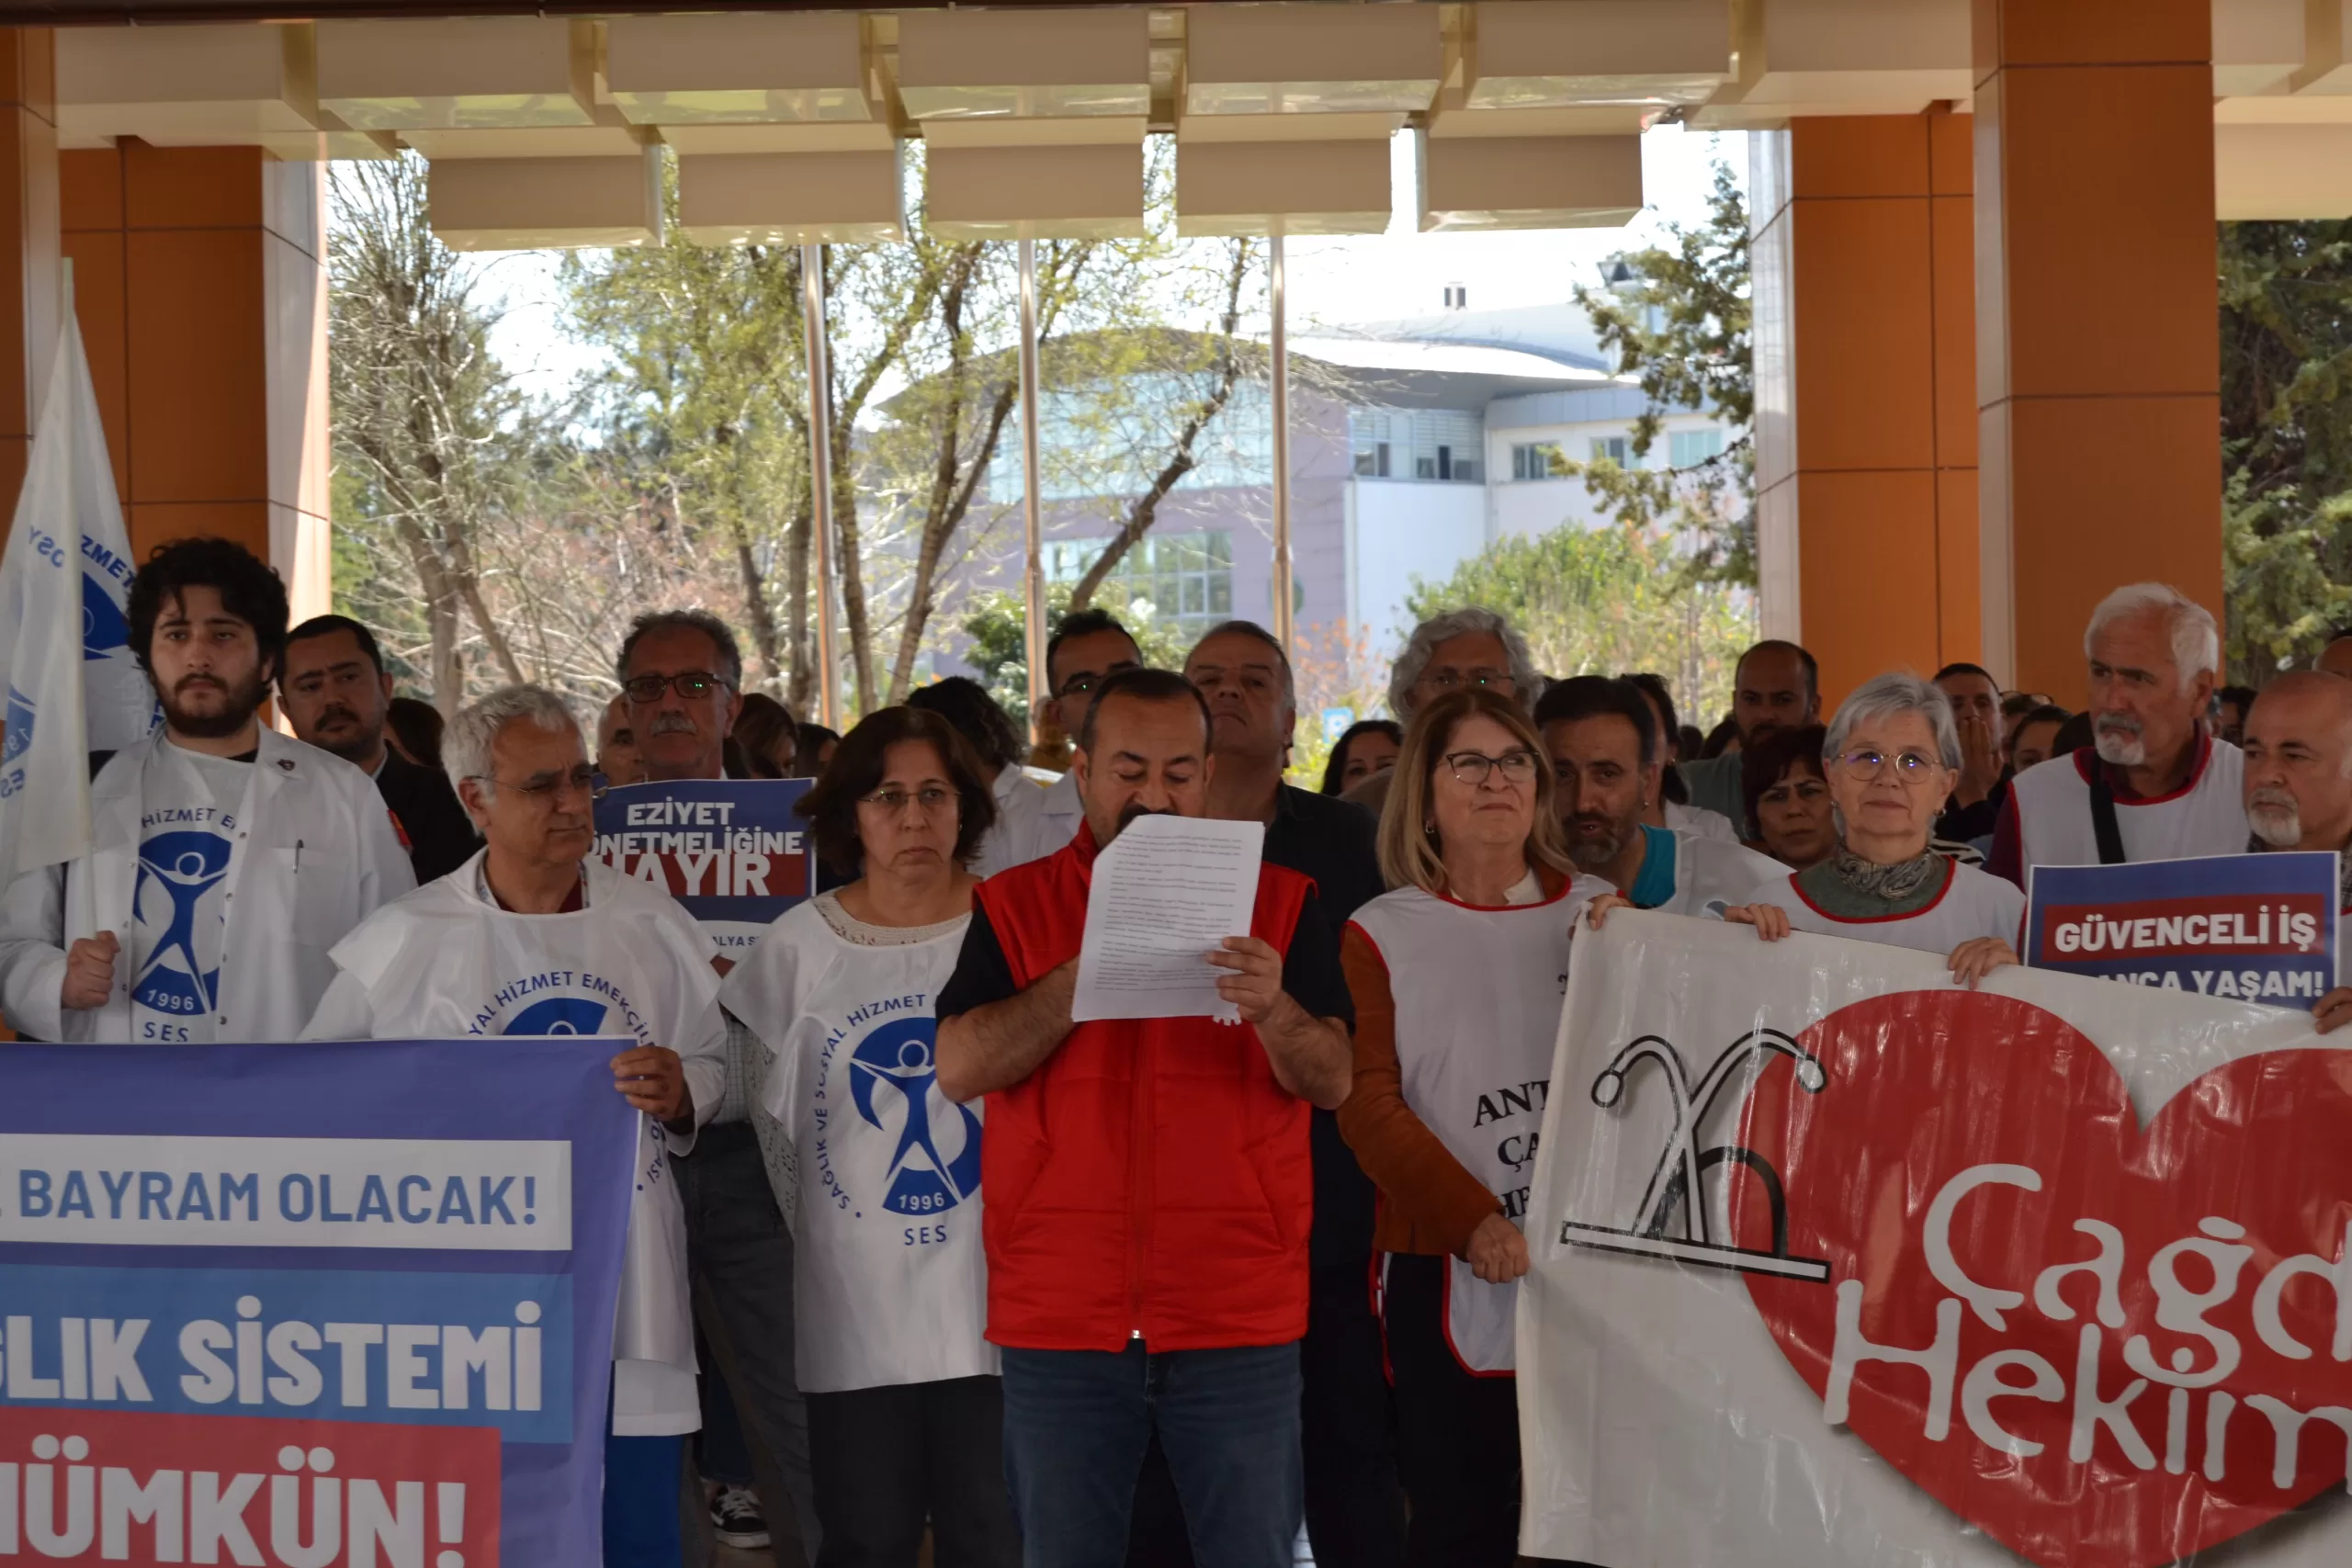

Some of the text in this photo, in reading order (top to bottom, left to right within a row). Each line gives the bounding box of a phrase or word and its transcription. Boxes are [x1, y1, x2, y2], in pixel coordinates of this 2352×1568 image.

[627, 795, 735, 826] EZİYET
[2055, 904, 2317, 953] GÜVENCELİ İŞ
[147, 988, 194, 1010] 1996
[494, 971, 574, 1008] HİZMET
[143, 1021, 189, 1043] SES
[814, 1108, 828, 1132] VE
[846, 993, 927, 1028] HİZMET
[19, 1169, 538, 1226] BAYRAM OLACAK!
[898, 1191, 945, 1211] 1996
[903, 1224, 947, 1247] SES
[178, 1295, 542, 1412] SİSTEMİ
[0, 1434, 467, 1568] ÜMKÜN!
